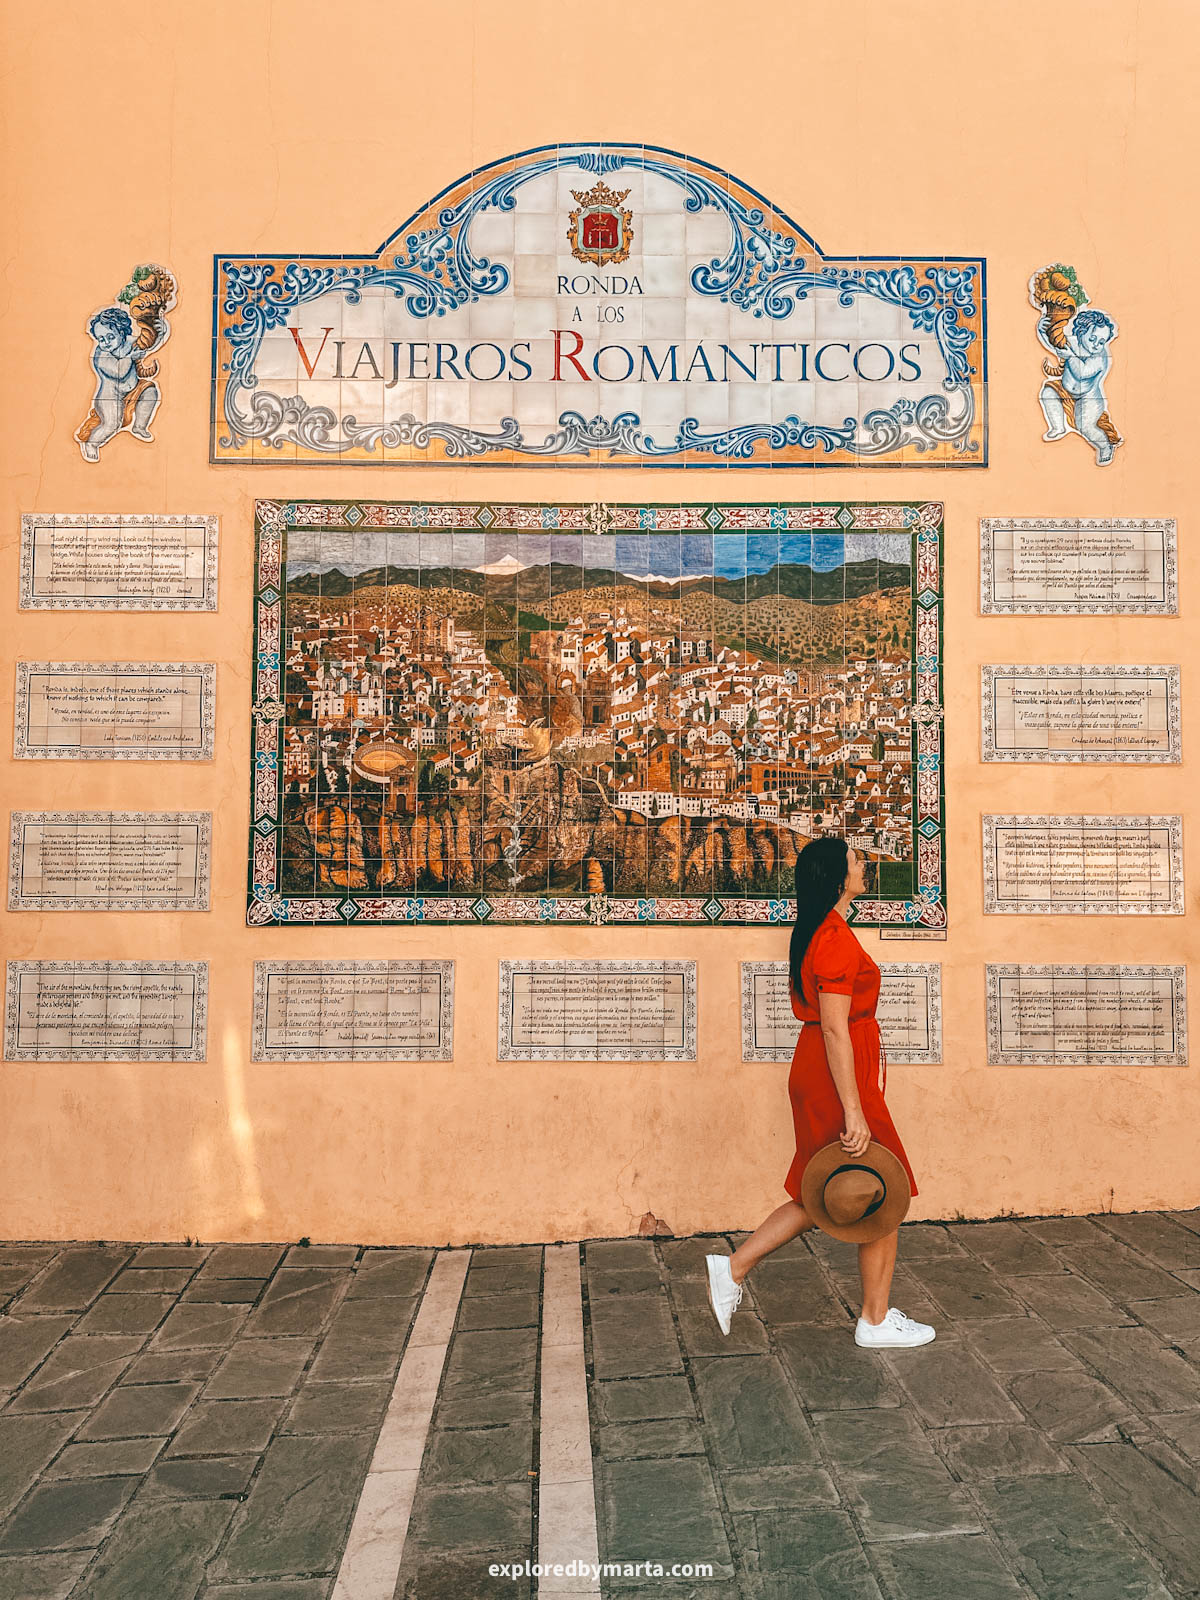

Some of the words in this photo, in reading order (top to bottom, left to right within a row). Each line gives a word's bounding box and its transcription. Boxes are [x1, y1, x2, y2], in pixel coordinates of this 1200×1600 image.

[557, 275, 643, 295] RONDA
[572, 305, 582, 323] A
[597, 305, 624, 323] LOS
[288, 327, 532, 389] VIAJEROS
[549, 329, 922, 382] ROMÁNTICOS
